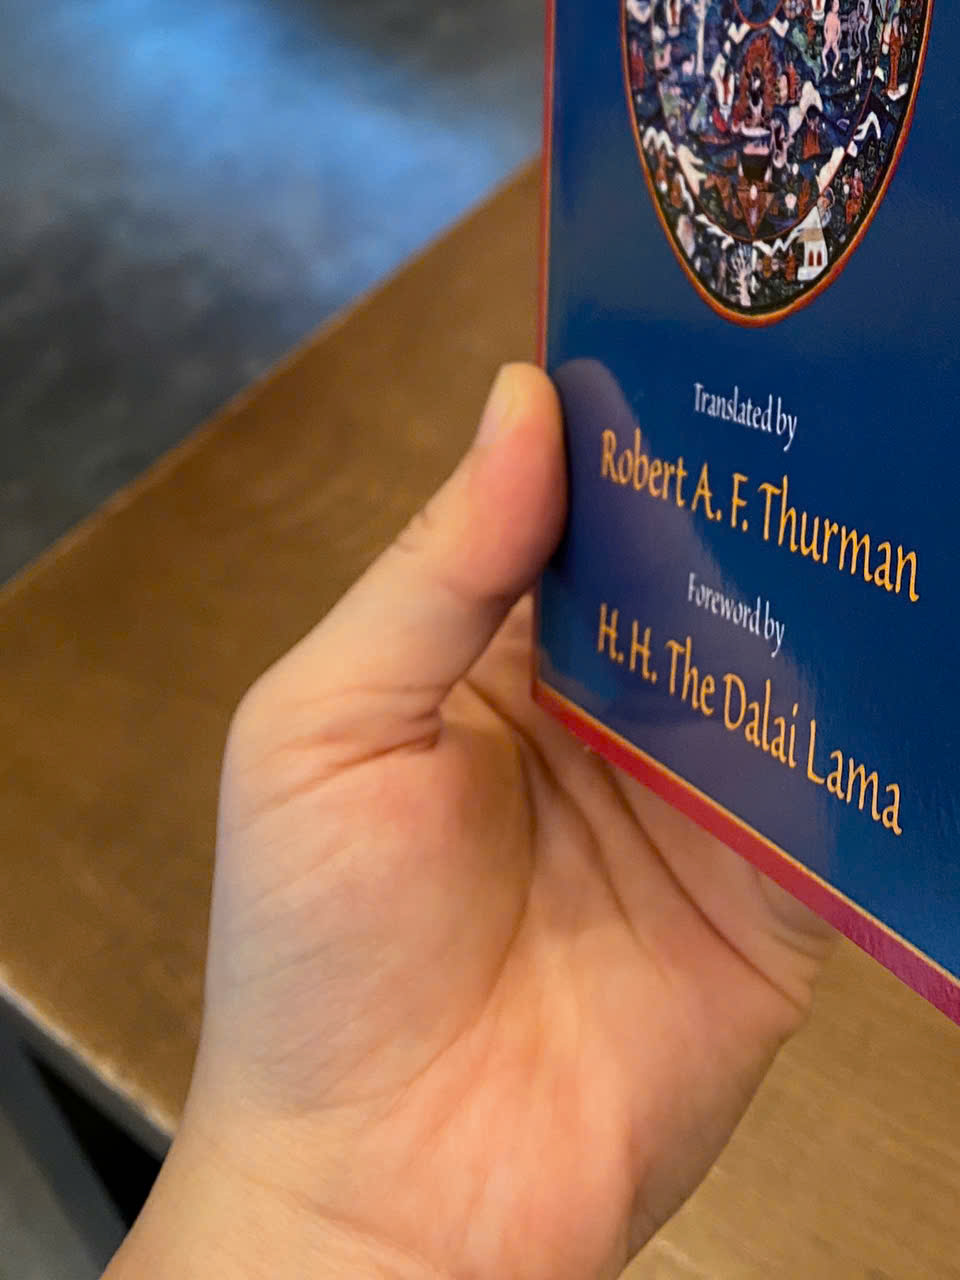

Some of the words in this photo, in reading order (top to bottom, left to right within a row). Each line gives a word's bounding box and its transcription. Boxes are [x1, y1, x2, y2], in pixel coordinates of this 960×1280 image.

[693, 382, 772, 434] Translated
[775, 396, 799, 453] by
[602, 427, 688, 508] Robert
[691, 462, 723, 522] A.
[730, 472, 750, 533] F.
[758, 475, 920, 603] Thurman
[687, 572, 761, 637] Foreword
[764, 600, 786, 659] by
[596, 602, 625, 663] H.
[629, 619, 658, 685] H.
[665, 635, 715, 717] The
[723, 672, 799, 769] Dalai
[805, 719, 904, 837] Lama
